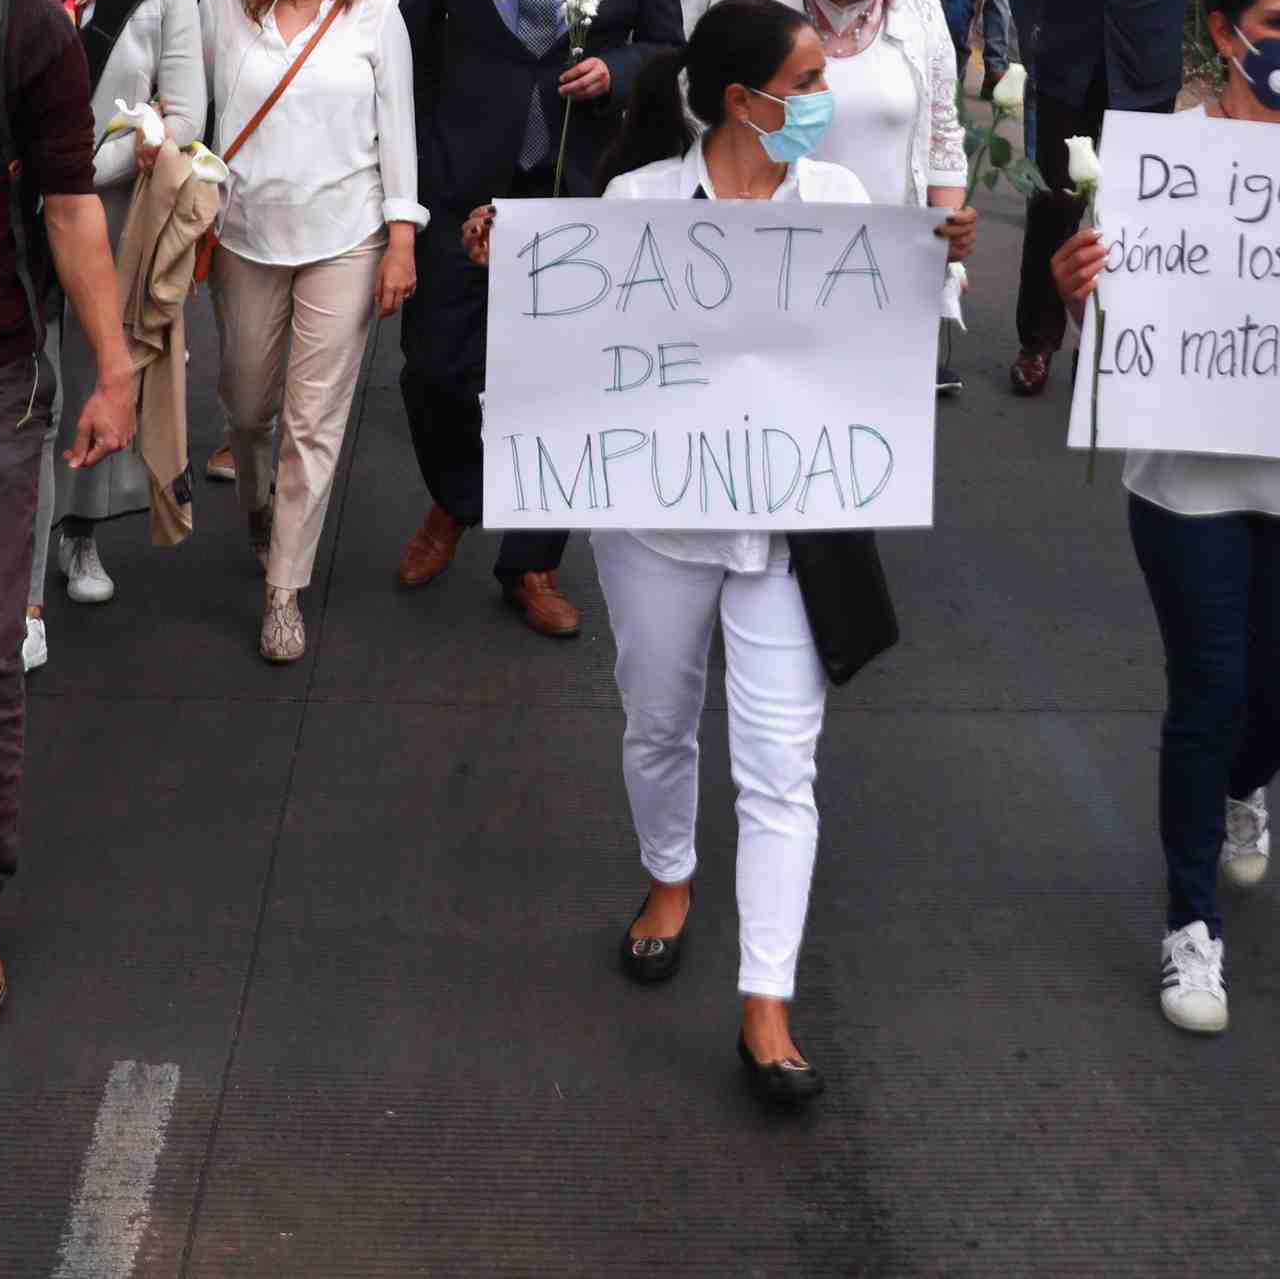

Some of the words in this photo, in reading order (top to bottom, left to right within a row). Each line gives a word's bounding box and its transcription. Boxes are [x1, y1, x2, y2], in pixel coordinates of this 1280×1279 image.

[1138, 153, 1199, 200] Da
[517, 222, 890, 318] BASTA
[601, 342, 710, 392] DE
